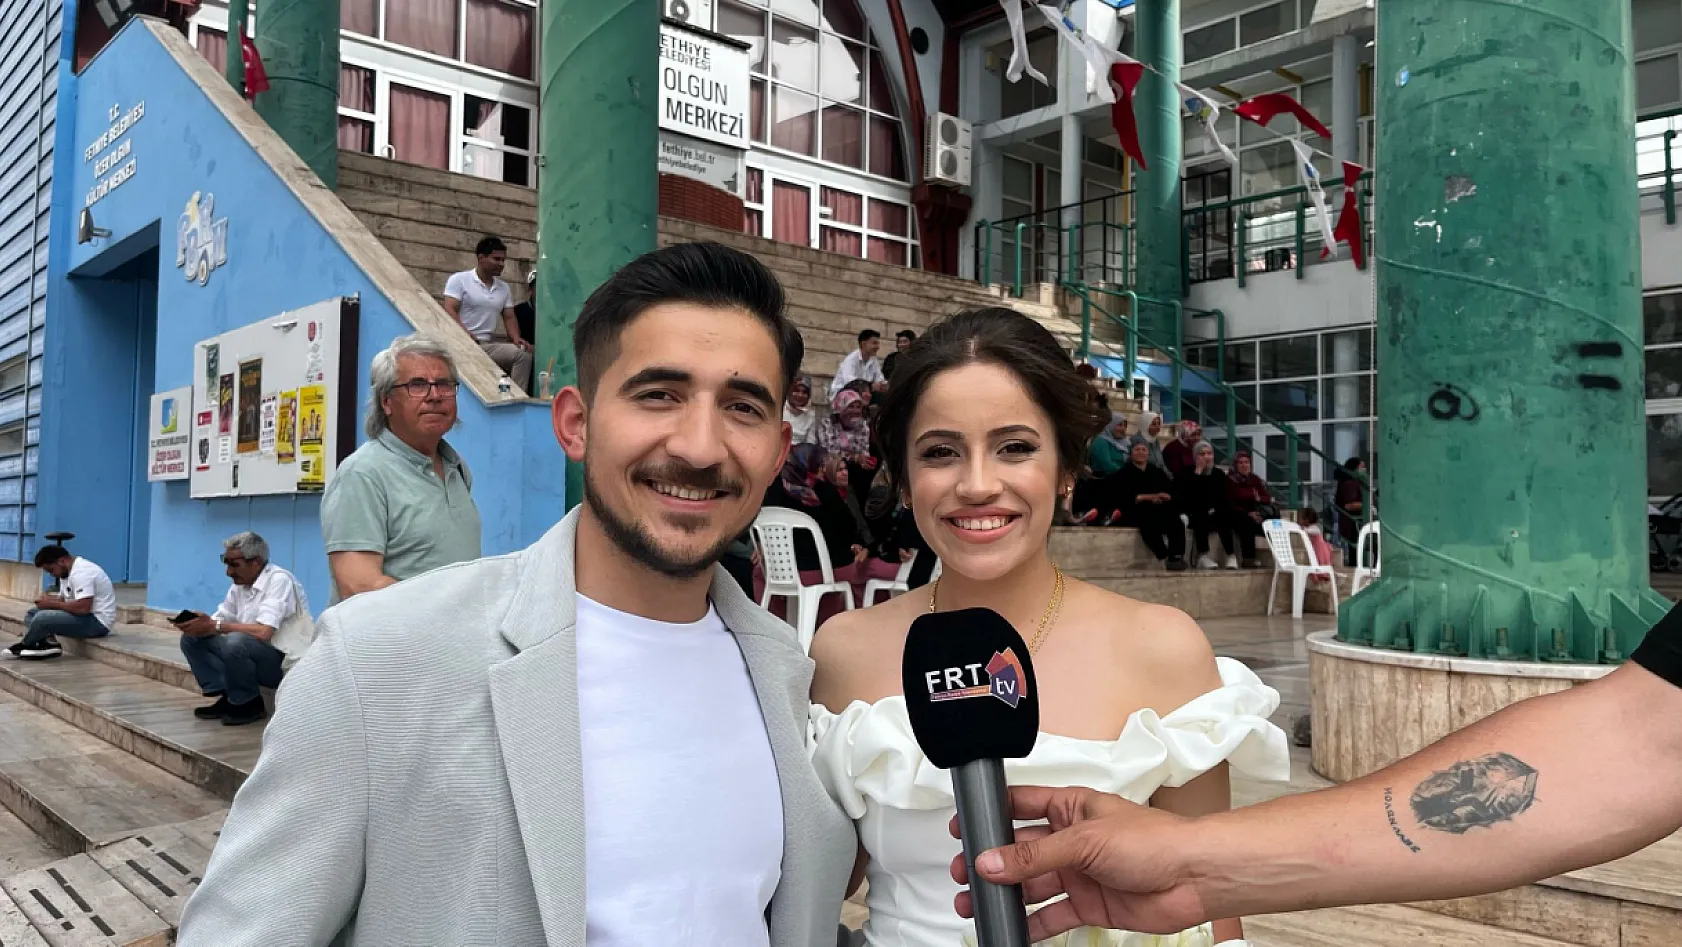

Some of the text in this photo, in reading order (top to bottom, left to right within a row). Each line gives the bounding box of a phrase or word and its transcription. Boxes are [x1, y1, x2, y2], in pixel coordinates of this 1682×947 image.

[659, 33, 711, 61] ETHİYE
[659, 47, 711, 72] ELEDİYESİ
[664, 67, 728, 106] OLGUN
[666, 97, 743, 139] MERKEZİ
[925, 663, 982, 694] FRT
[996, 678, 1015, 695] tv
